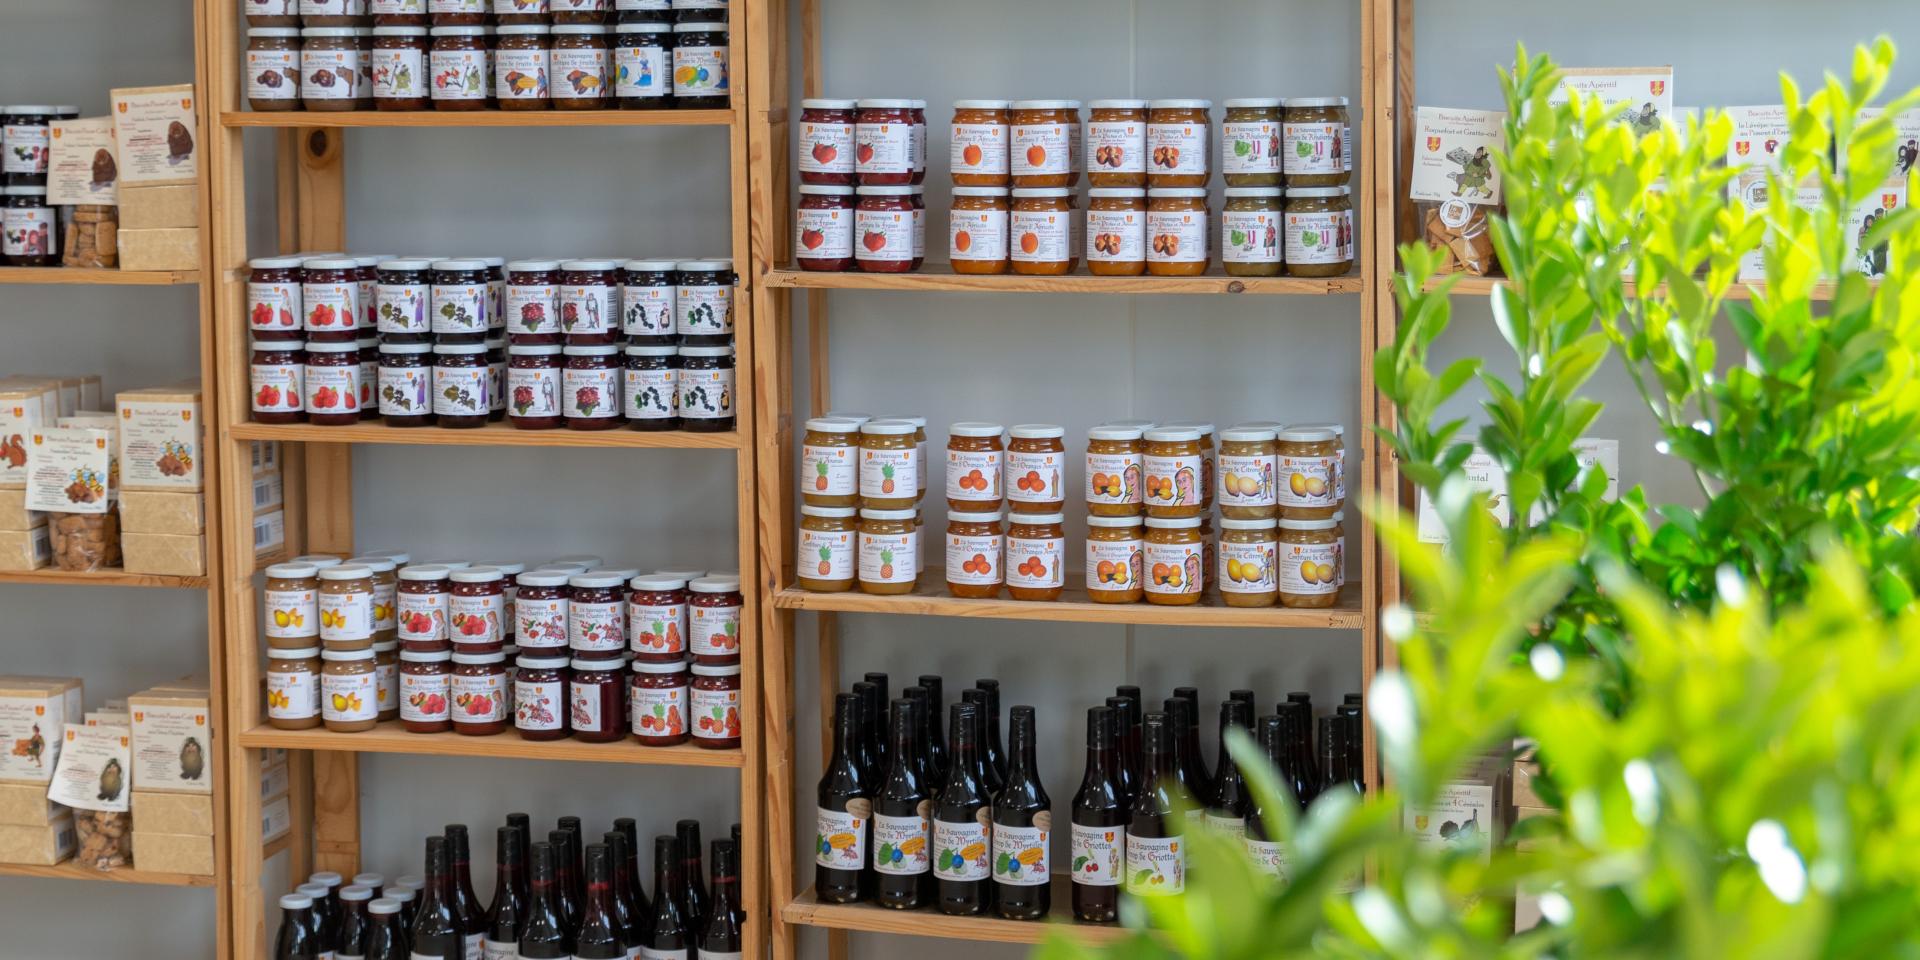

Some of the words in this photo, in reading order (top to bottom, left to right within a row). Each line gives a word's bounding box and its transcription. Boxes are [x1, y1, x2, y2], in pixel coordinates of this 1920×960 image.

[1424, 126, 1454, 136] Roquefort
[887, 822, 918, 832] Sauvagine
[947, 828, 978, 837] Sauvagine
[1004, 832, 1035, 842] Sauvagine
[1084, 839, 1111, 850] Griottes
[1136, 842, 1168, 852] Sauvagine
[1148, 851, 1177, 862] Griottes
